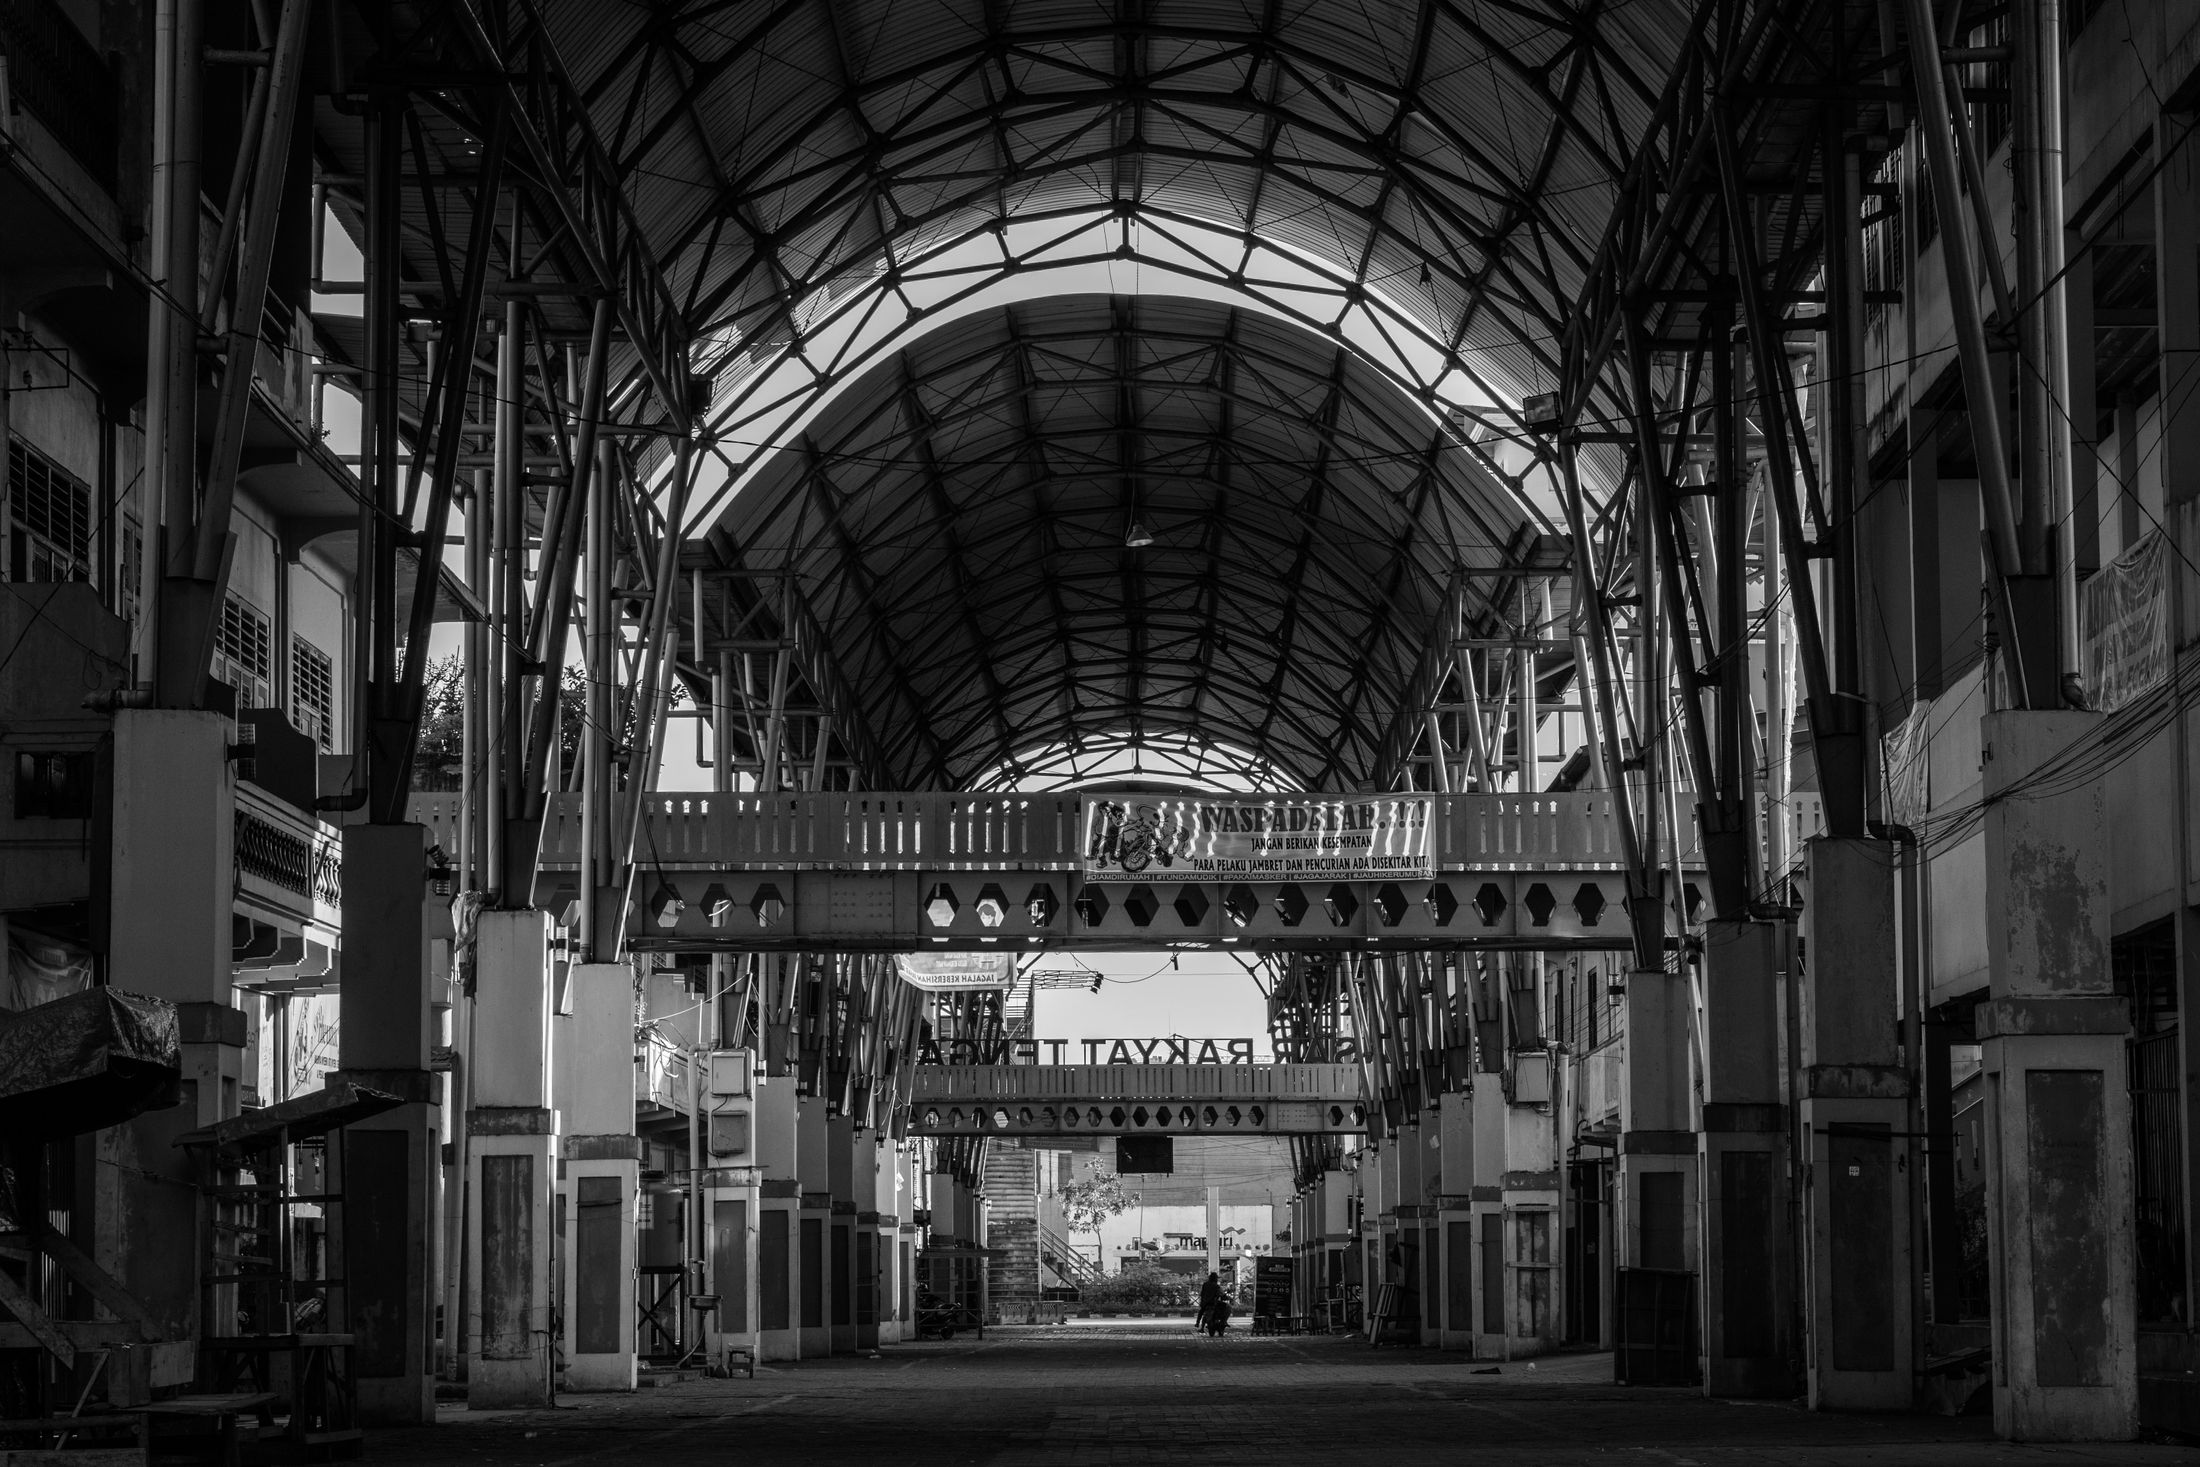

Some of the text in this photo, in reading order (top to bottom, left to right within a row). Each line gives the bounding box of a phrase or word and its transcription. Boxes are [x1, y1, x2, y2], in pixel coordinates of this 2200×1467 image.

[1251, 835, 1372, 852] JANGAN BERIKAN KESEMPATAN
[1194, 859, 1214, 871] PARA
[1217, 859, 1246, 871] PELAKU
[1249, 858, 1284, 873] JAMBRET
[1286, 858, 1302, 871] DAN
[1305, 857, 1350, 871] PENCURIAN
[1352, 857, 1369, 870] ADA
[1372, 855, 1412, 869] DISEKITAR
[1223, 873, 1287, 881] #PAKAIMASKER
[1180, 1236, 1232, 1247] maniri
